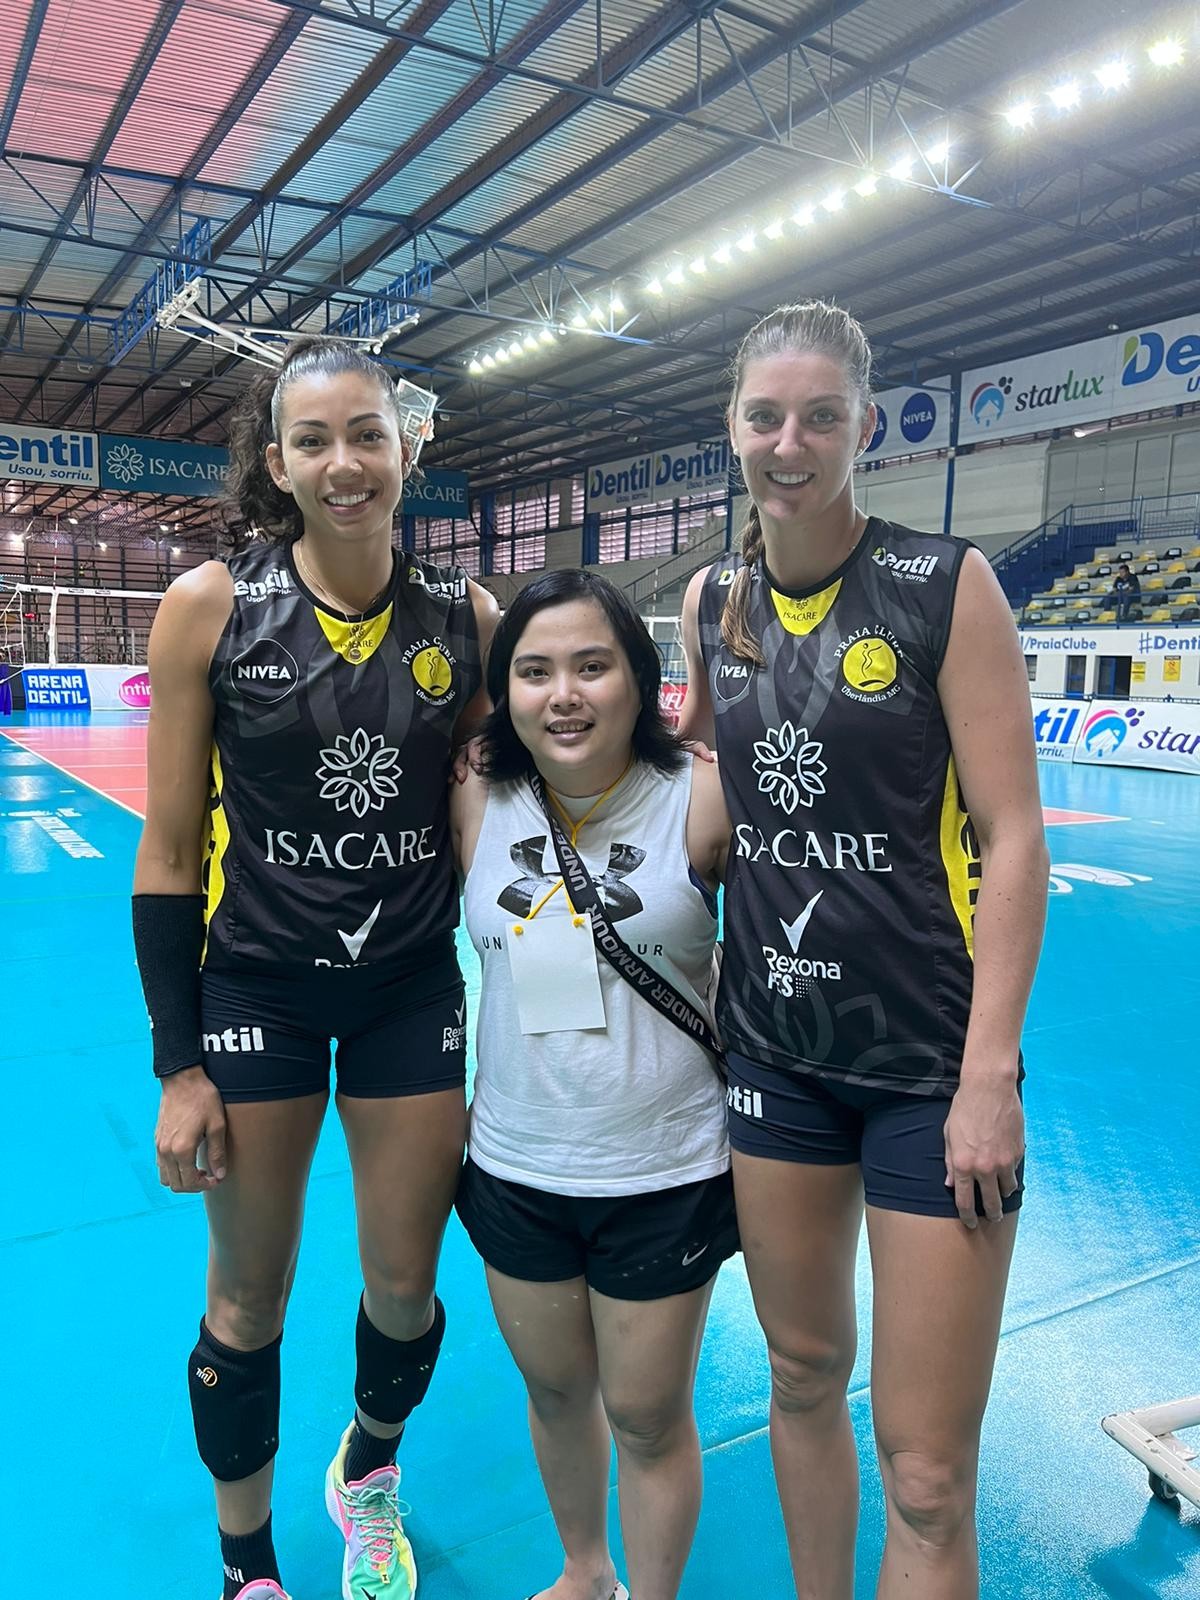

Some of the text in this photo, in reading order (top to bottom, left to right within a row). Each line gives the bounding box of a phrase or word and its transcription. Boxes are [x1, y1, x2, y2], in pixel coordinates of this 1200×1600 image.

[1015, 369, 1104, 412] starlux
[903, 410, 933, 426] NIVEA
[9, 463, 93, 481] Usou, sorriu.
[150, 458, 228, 481] ISACARE
[655, 439, 728, 486] Dentil
[590, 458, 651, 498] Dentil
[403, 482, 465, 503] SACARE
[872, 547, 939, 576] Dentil
[783, 610, 818, 622] ISACARE
[401, 639, 430, 665] PRAIA
[834, 627, 871, 658] PRAIA
[28, 675, 83, 689] ARENA
[237, 665, 292, 679] NIVEA
[28, 690, 87, 704] DENTIL
[886, 684, 901, 698] MG
[264, 825, 437, 870] ISACARE
[585, 903, 705, 1036] UNDER ARMOUR
[762, 945, 841, 980] Rexona
[442, 1037, 460, 1052] PES
